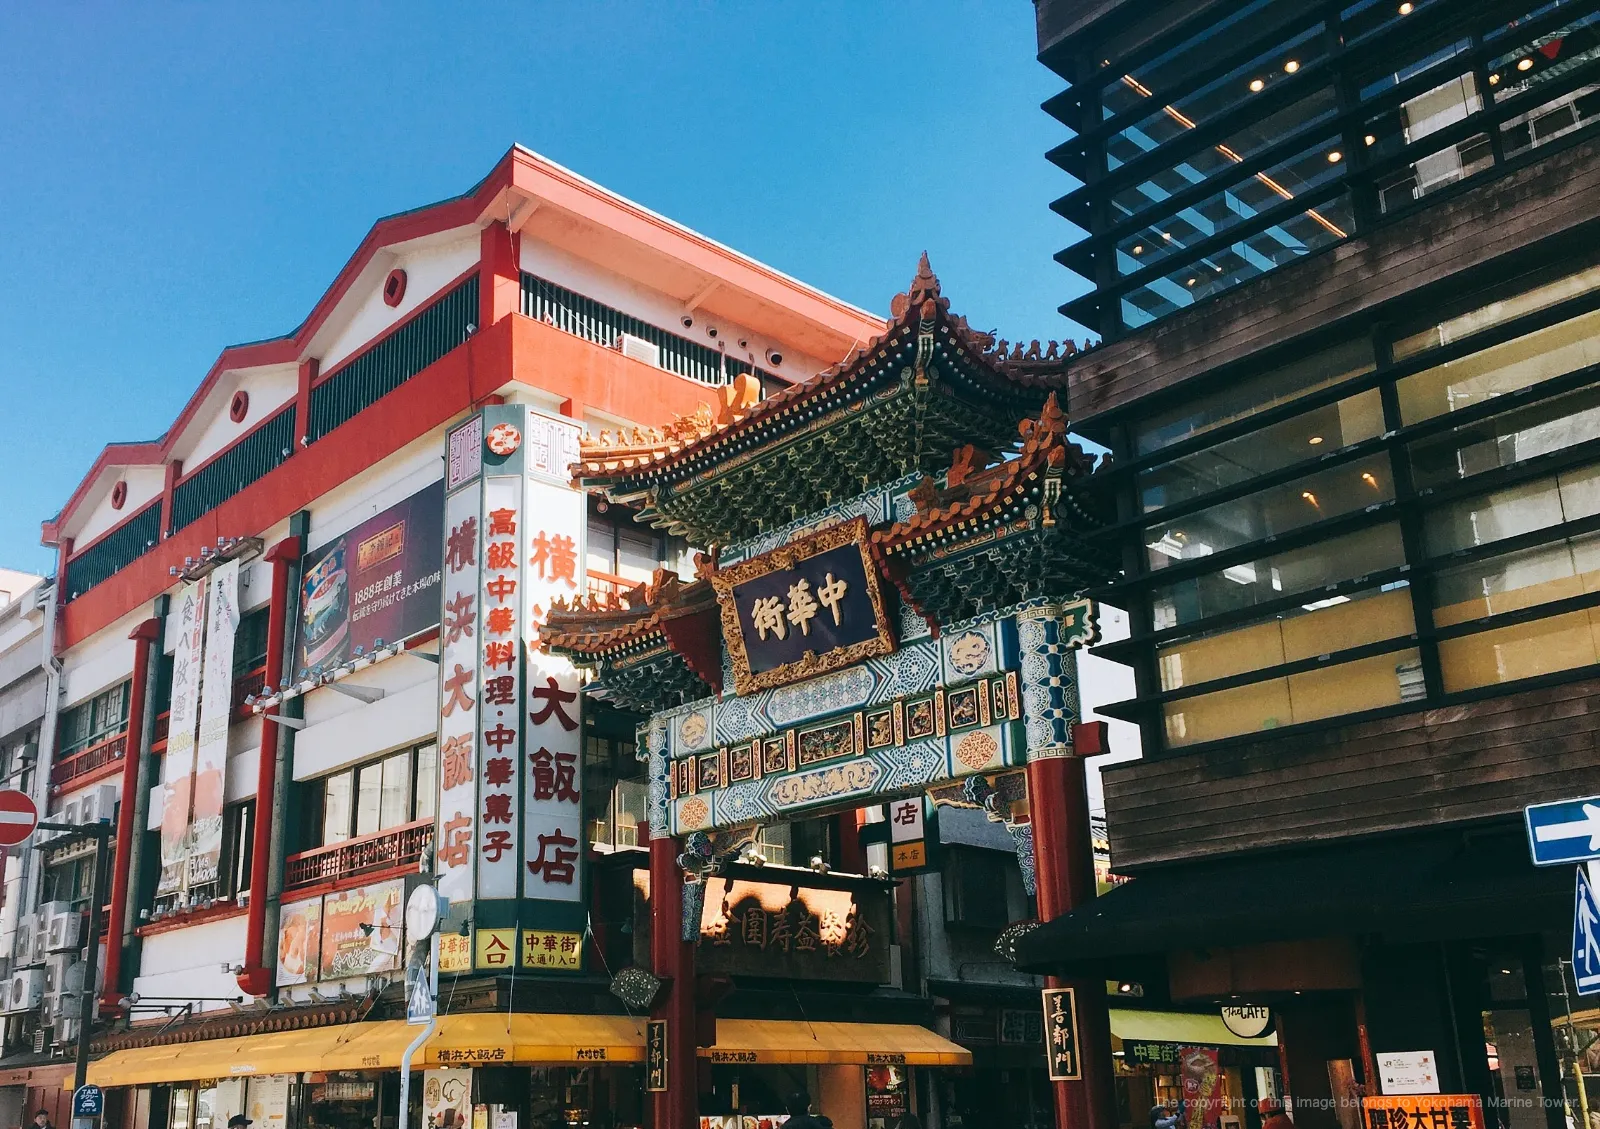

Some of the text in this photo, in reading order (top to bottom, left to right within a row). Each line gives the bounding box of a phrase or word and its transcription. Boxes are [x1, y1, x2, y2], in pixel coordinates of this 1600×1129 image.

[354, 571, 403, 606] 1888年創業
[894, 803, 918, 826] 店
[897, 849, 920, 862] 本店
[526, 933, 577, 954] 中華街
[526, 953, 577, 966] 大通り入口
[438, 1048, 506, 1062] 横浜大飯店
[711, 1052, 758, 1063] 横浜大飯店
